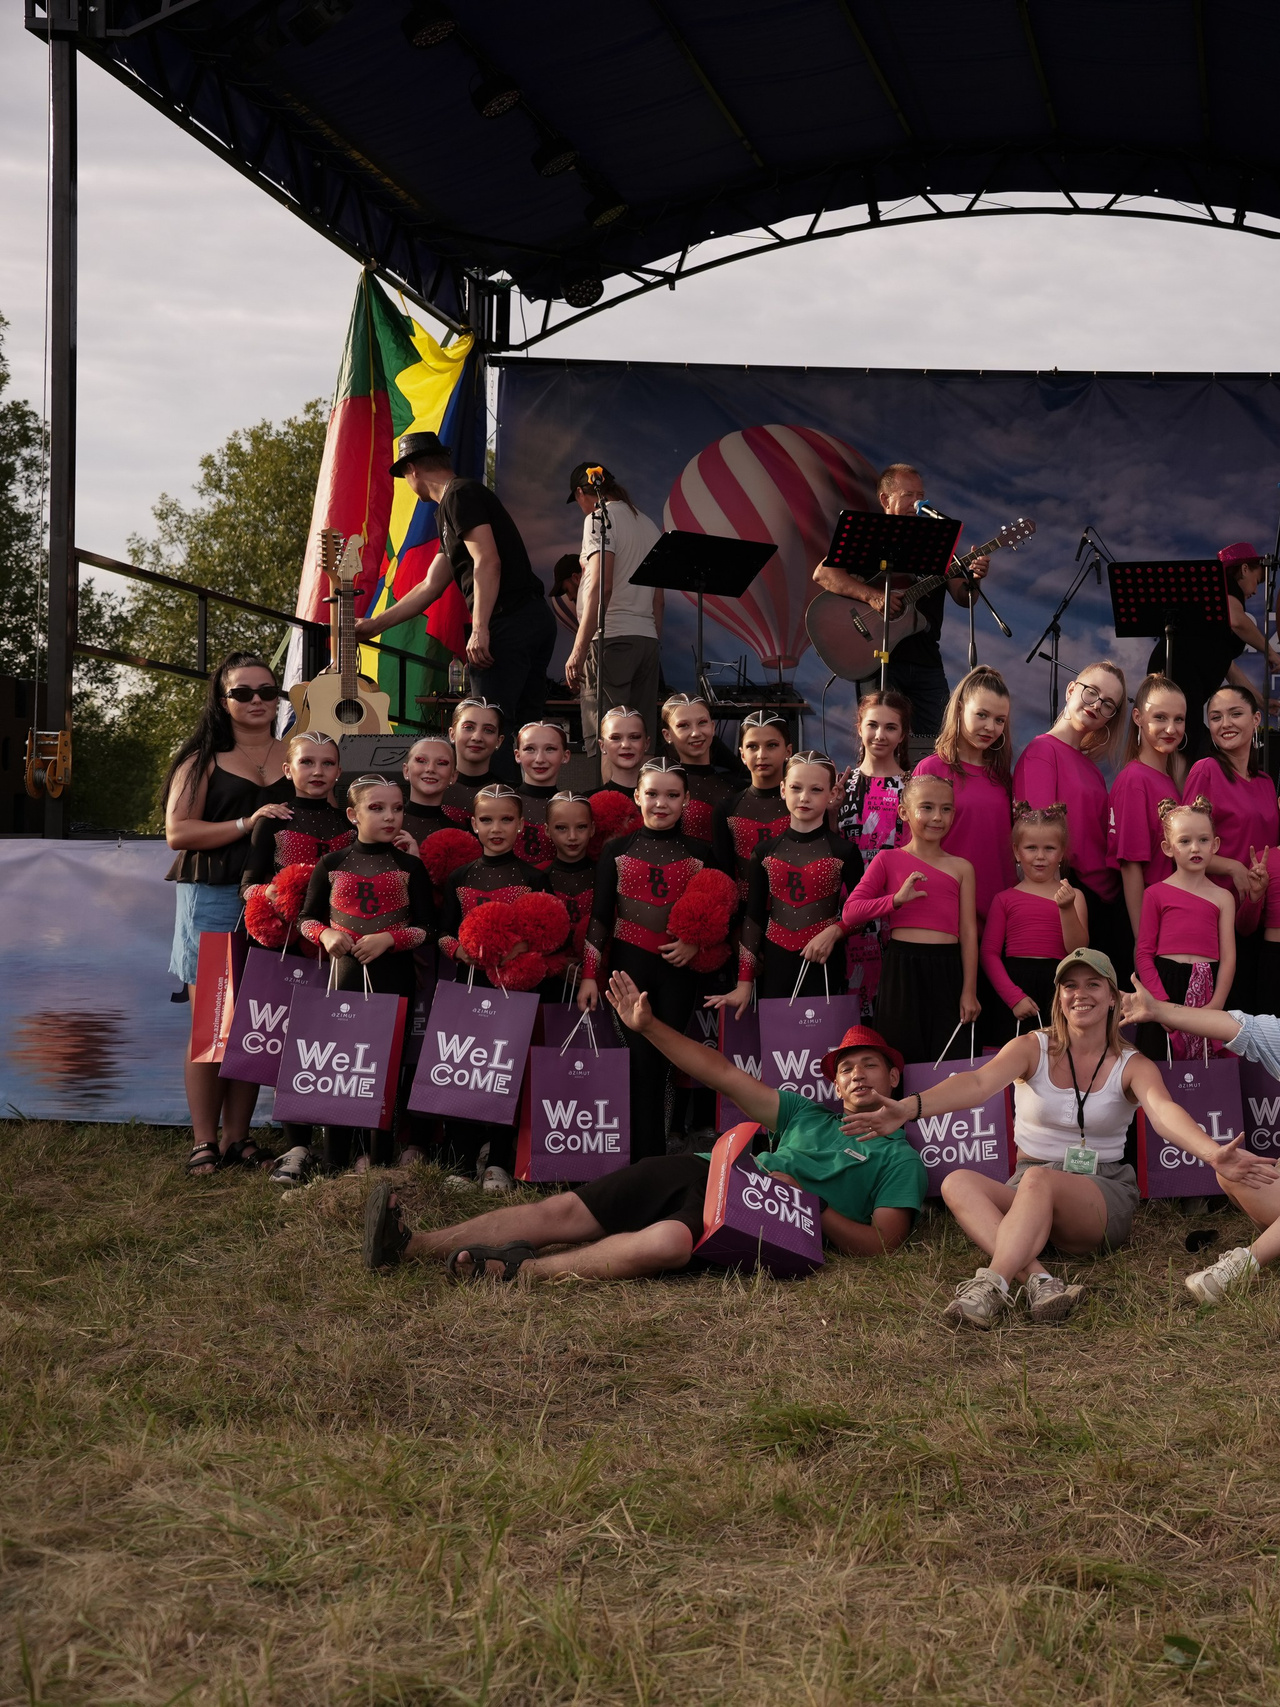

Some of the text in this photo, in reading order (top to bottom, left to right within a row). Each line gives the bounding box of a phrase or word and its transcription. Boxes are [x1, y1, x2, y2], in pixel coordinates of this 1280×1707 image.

[242, 1031, 282, 1055] Co
[296, 1039, 377, 1074] WeL
[437, 1031, 514, 1071] WeL
[430, 1063, 512, 1095] CoME
[772, 1047, 838, 1080] We
[292, 1071, 376, 1098] CoME
[542, 1099, 619, 1130] WeL
[917, 1107, 995, 1143] WeL
[544, 1131, 621, 1153] CoME
[920, 1139, 998, 1167] CoME
[736, 1165, 812, 1217] WeL
[742, 1187, 814, 1236] CoME
